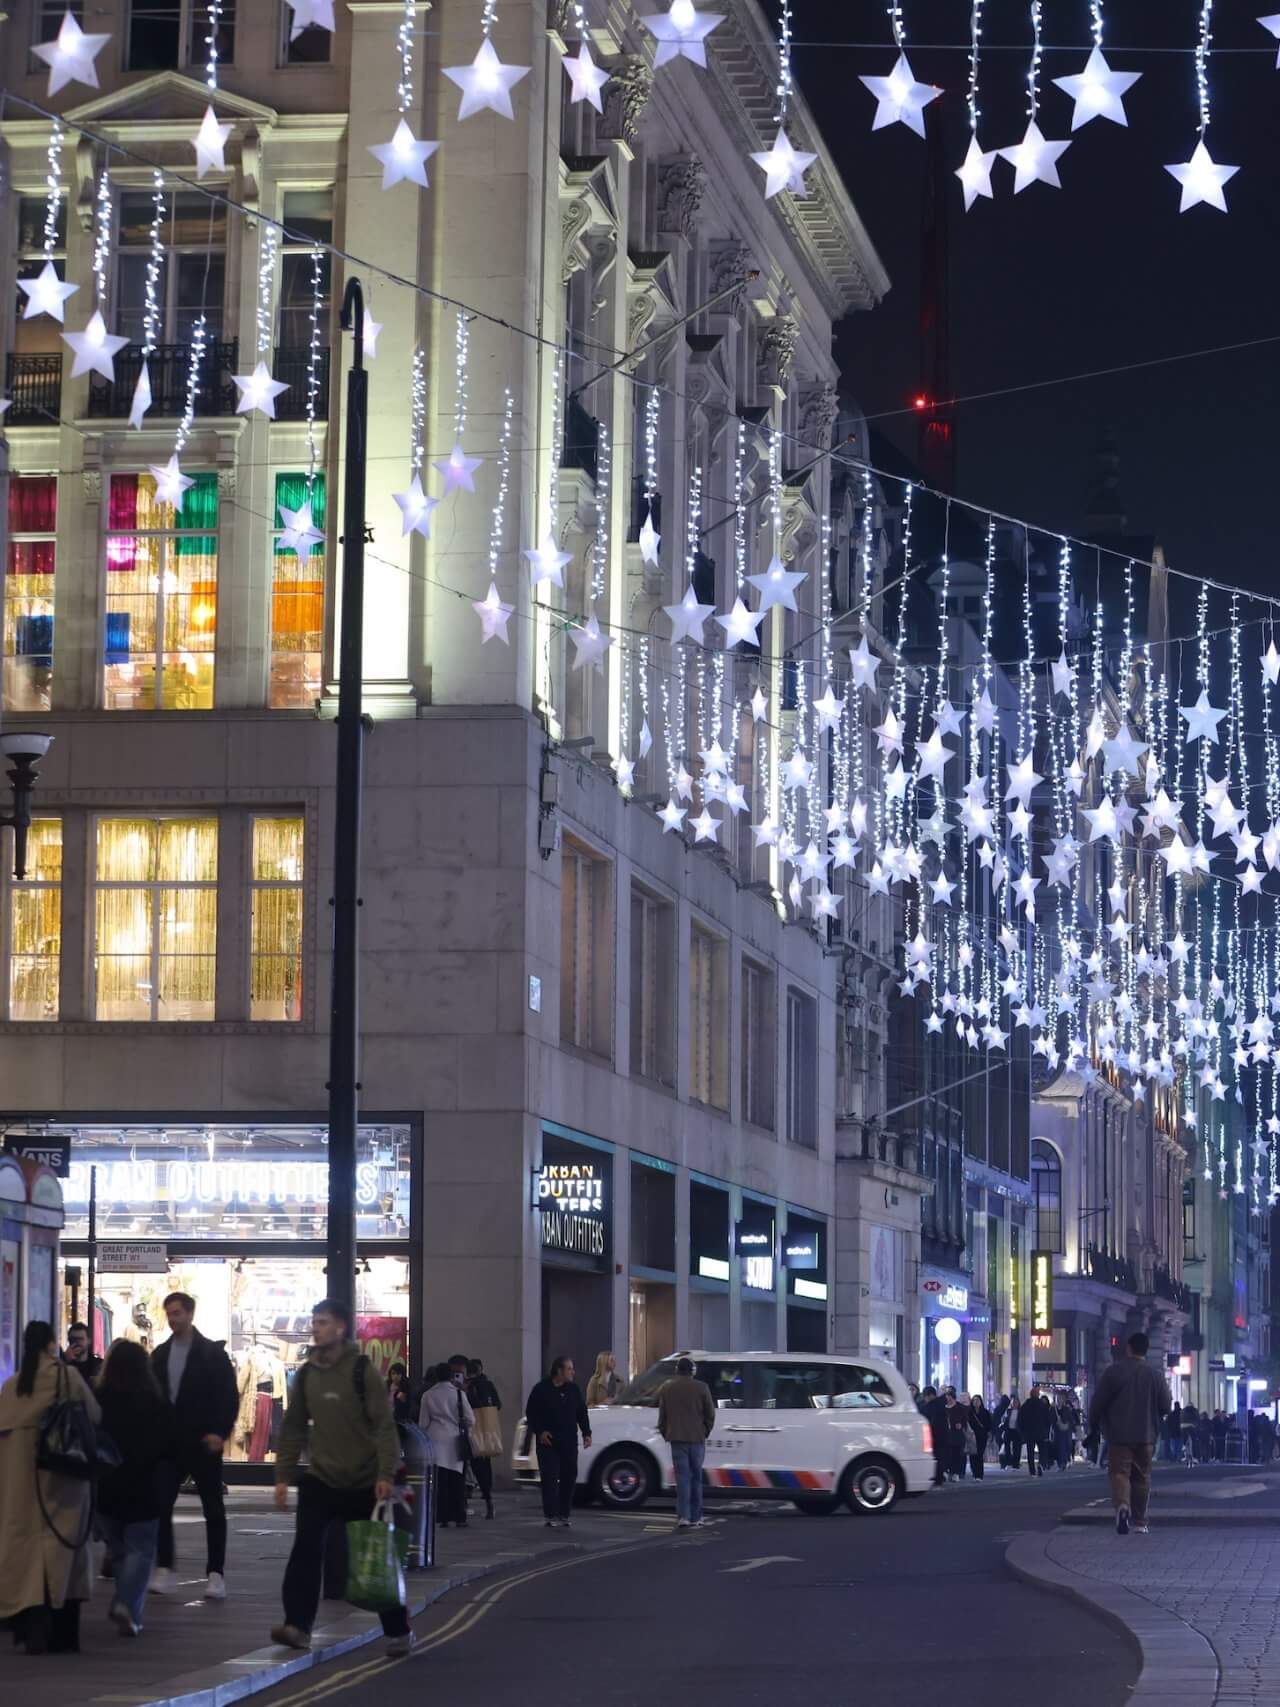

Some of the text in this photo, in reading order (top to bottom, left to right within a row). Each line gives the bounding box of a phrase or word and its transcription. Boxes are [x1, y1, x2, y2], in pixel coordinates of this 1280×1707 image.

[68, 1160, 378, 1204] RBAN OUTFITTES
[539, 1179, 602, 1198] OUTFIT
[556, 1197, 603, 1212] TERS
[563, 1213, 604, 1255] OUTFITTERS
[740, 1234, 768, 1244] schuh
[125, 1246, 162, 1254] PORTLAND
[785, 1246, 812, 1255] schuh
[102, 1253, 140, 1261] STREET W1
